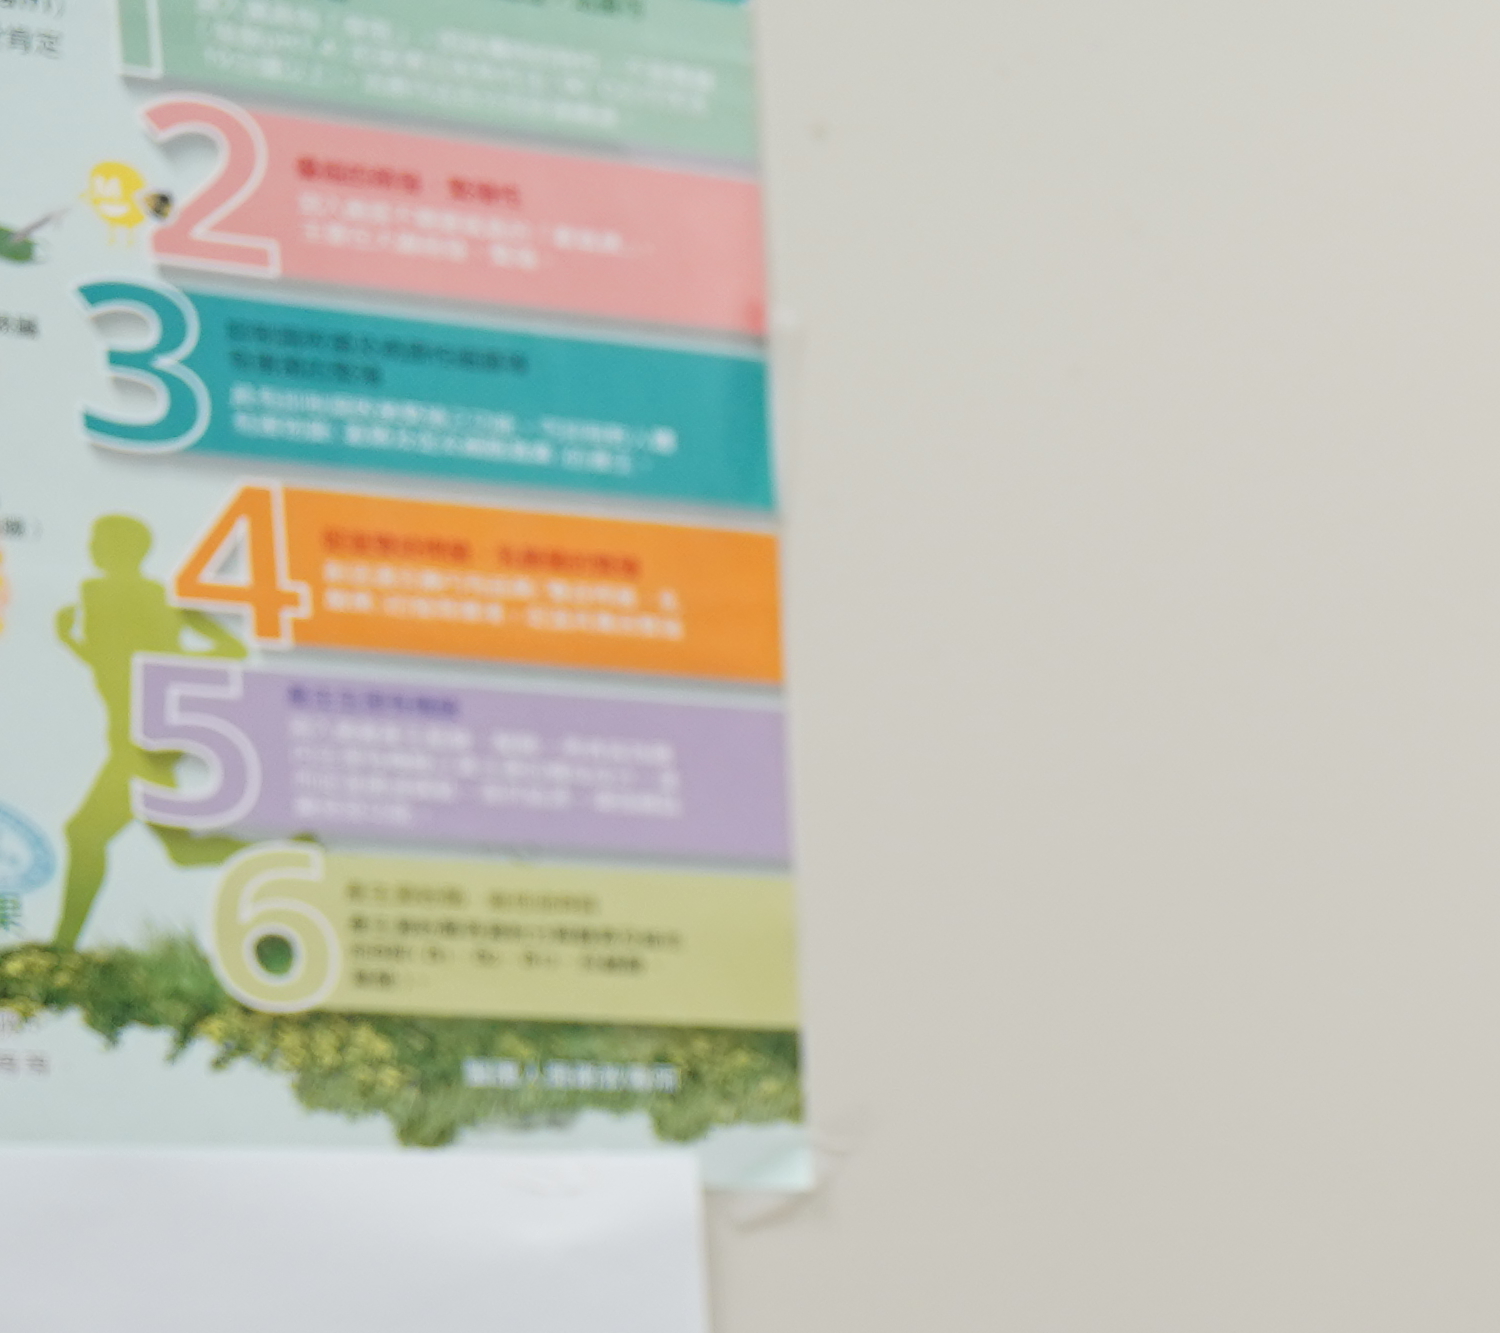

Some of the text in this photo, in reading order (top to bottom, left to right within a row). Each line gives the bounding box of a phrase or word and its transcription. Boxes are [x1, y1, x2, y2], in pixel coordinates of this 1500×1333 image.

[140, 93, 280, 278] 2
[73, 277, 212, 455] 3
[174, 480, 312, 650] 4
[130, 652, 262, 830] 5
[210, 840, 342, 1012] 6
